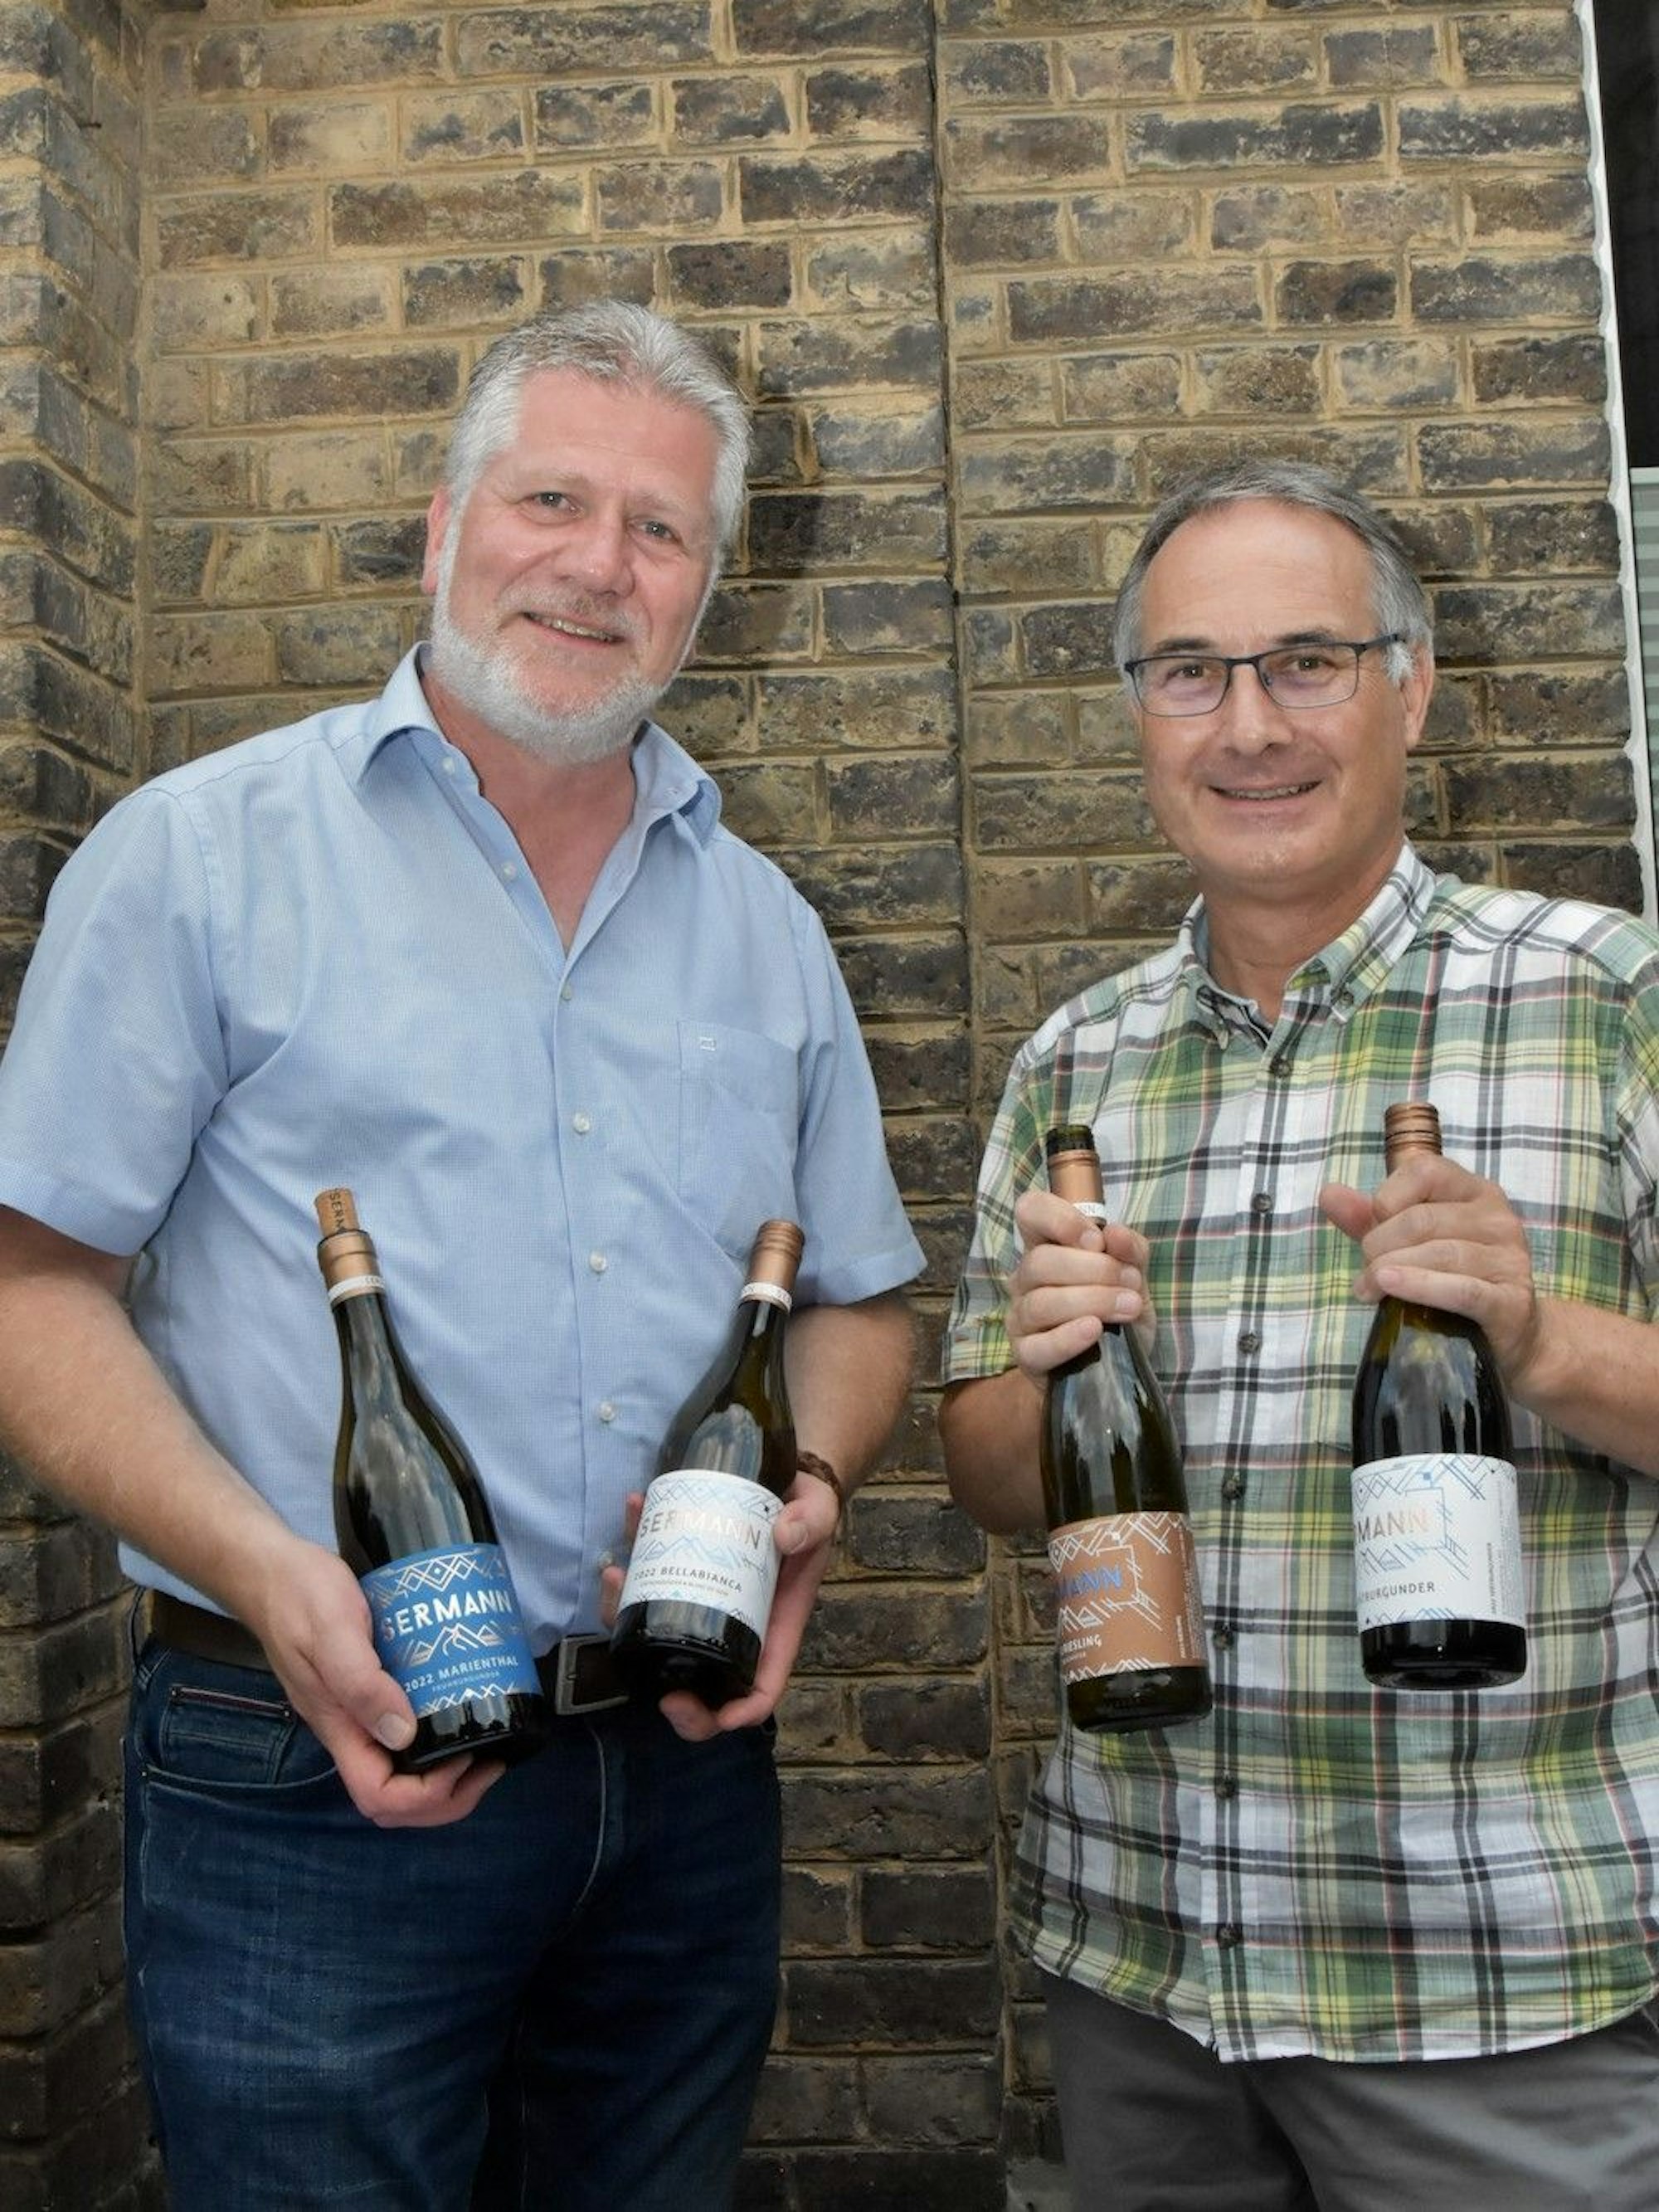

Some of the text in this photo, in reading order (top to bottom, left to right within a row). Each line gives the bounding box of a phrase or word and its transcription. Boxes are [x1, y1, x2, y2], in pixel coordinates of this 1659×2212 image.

[640, 1509, 761, 1551] SERMANN
[1352, 1508, 1429, 1544] MANN
[660, 1566, 742, 1593] BELLABIANCA
[382, 1590, 513, 1642] SERMANN
[403, 1655, 519, 1693] 2022 MARIENTHAL
